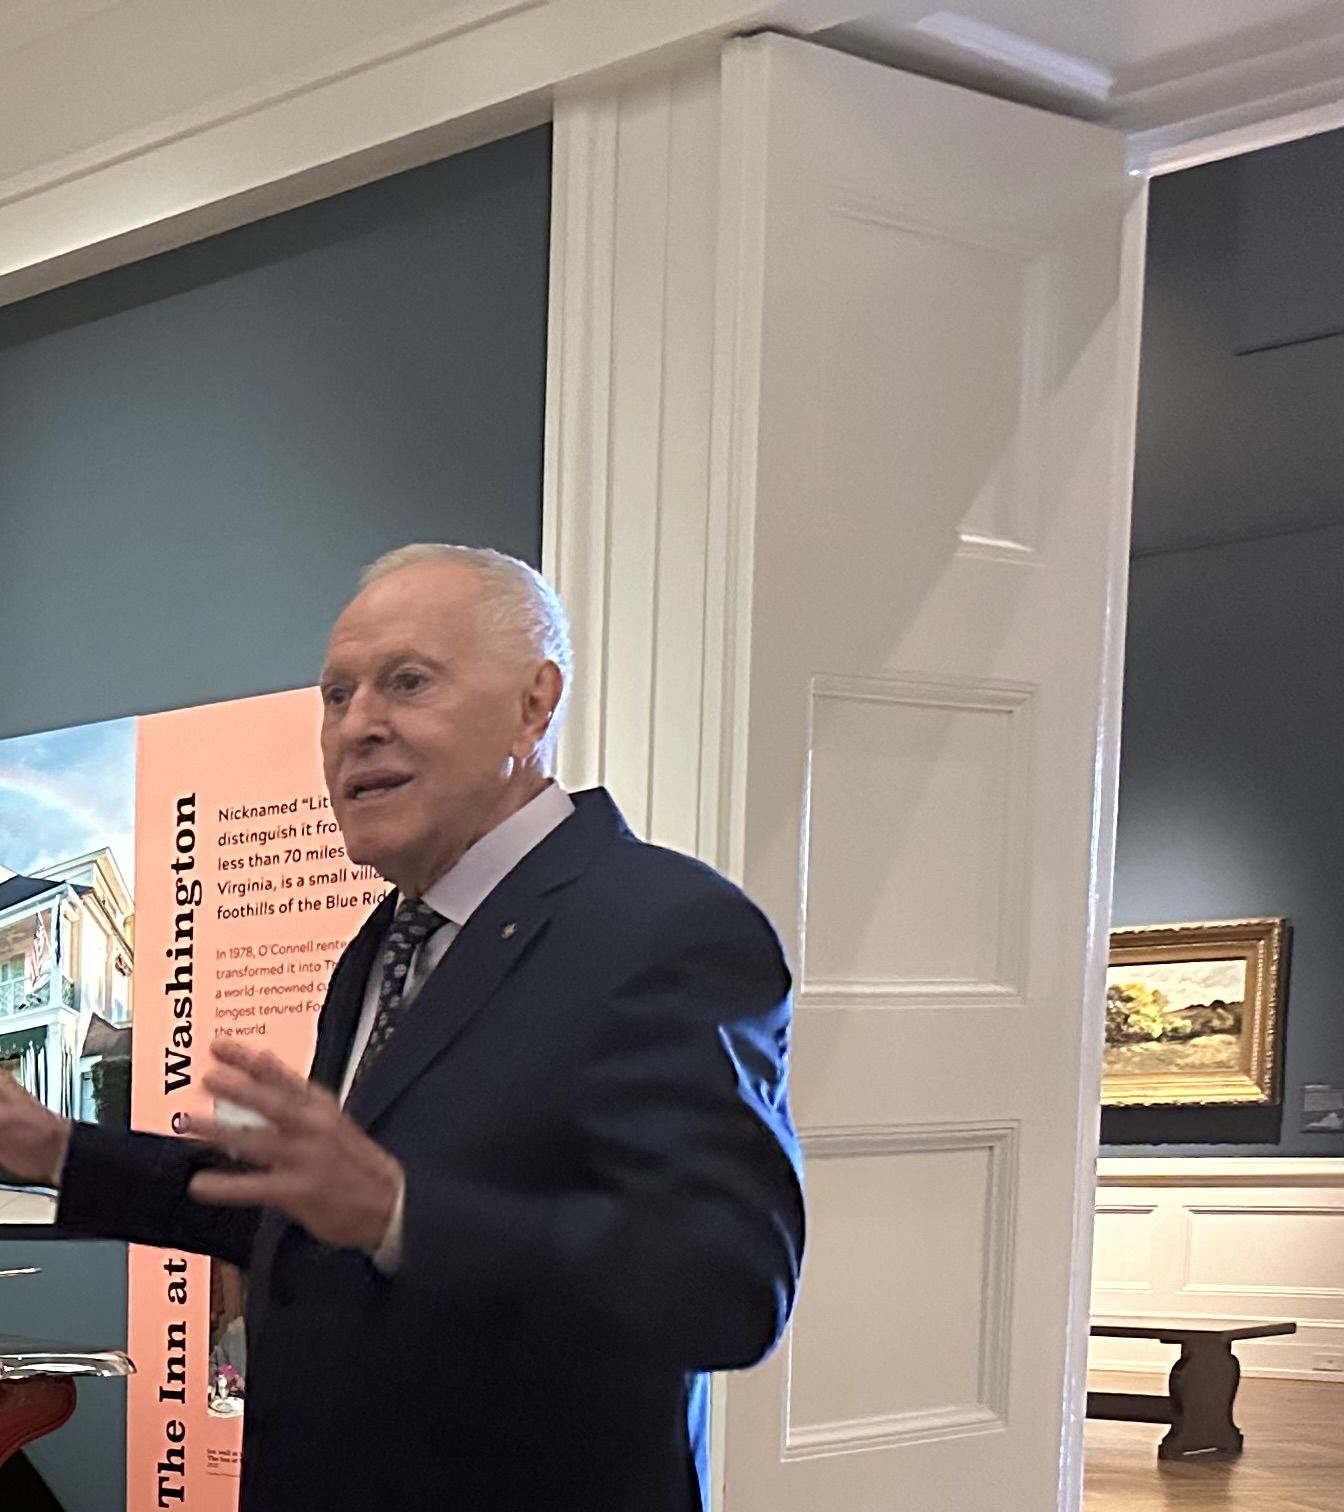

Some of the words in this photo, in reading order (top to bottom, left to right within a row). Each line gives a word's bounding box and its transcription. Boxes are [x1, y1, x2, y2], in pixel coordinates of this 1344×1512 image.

[218, 799, 298, 822] Nicknamed
[218, 824, 297, 846] distinguish
[301, 823, 312, 836] it
[218, 858, 245, 871] less
[248, 853, 280, 868] than
[284, 849, 302, 864] 70
[306, 845, 345, 861] miles
[217, 875, 278, 898] Virginia,
[281, 874, 293, 889] is
[296, 876, 305, 887] a
[309, 868, 347, 886] small
[351, 865, 382, 880] villa
[217, 901, 275, 920] foothills
[278, 898, 294, 914] of
[298, 898, 322, 913] the
[326, 894, 358, 910] Blue
[362, 889, 388, 906] Rid
[164, 791, 203, 1096] Washington
[216, 949, 226, 960] In
[229, 945, 256, 959] 1978,
[258, 940, 314, 957] O'Connell
[216, 963, 284, 980] transformed
[287, 962, 295, 974] it
[298, 962, 321, 973] into
[215, 990, 222, 999] a
[224, 981, 314, 998] world-renowned
[215, 1006, 256, 1020] longest
[259, 1001, 303, 1015] tenured
[215, 1026, 233, 1037] the
[164, 1257, 188, 1305] at
[158, 1320, 187, 1405] Inn
[157, 1418, 186, 1509] The
